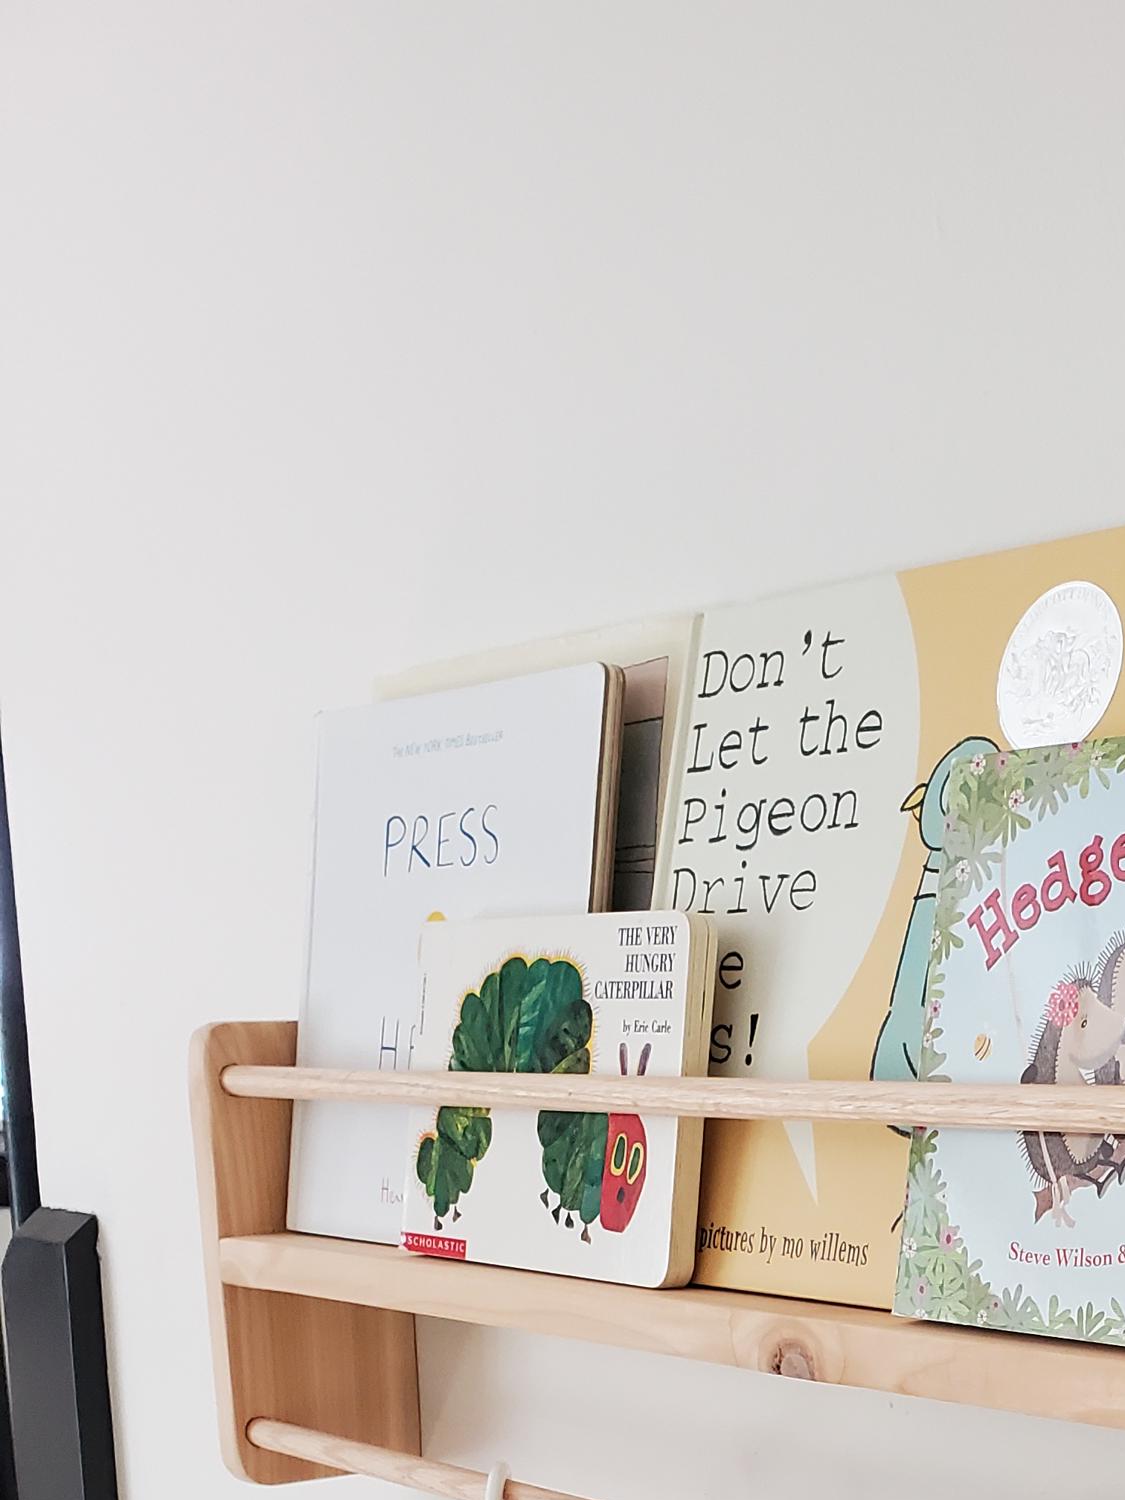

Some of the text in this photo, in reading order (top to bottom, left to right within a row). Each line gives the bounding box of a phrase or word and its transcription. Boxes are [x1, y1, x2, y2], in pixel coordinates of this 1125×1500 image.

[697, 630, 846, 699] Don't
[687, 699, 883, 774] Let the
[678, 788, 860, 851] Pigeon
[384, 804, 500, 877] PRESS
[672, 860, 817, 914] Drive
[618, 925, 678, 947] THE VERY
[625, 952, 676, 973] HUNGRY
[594, 979, 674, 1000] CATERPILLAR
[622, 1018, 672, 1036] by Eric Carle
[407, 1235, 465, 1254] SCHOLASTIC
[700, 1222, 870, 1267] pictures by mo willems
[1008, 1241, 1051, 1266] Steve
[1056, 1247, 1113, 1268] Wilson
